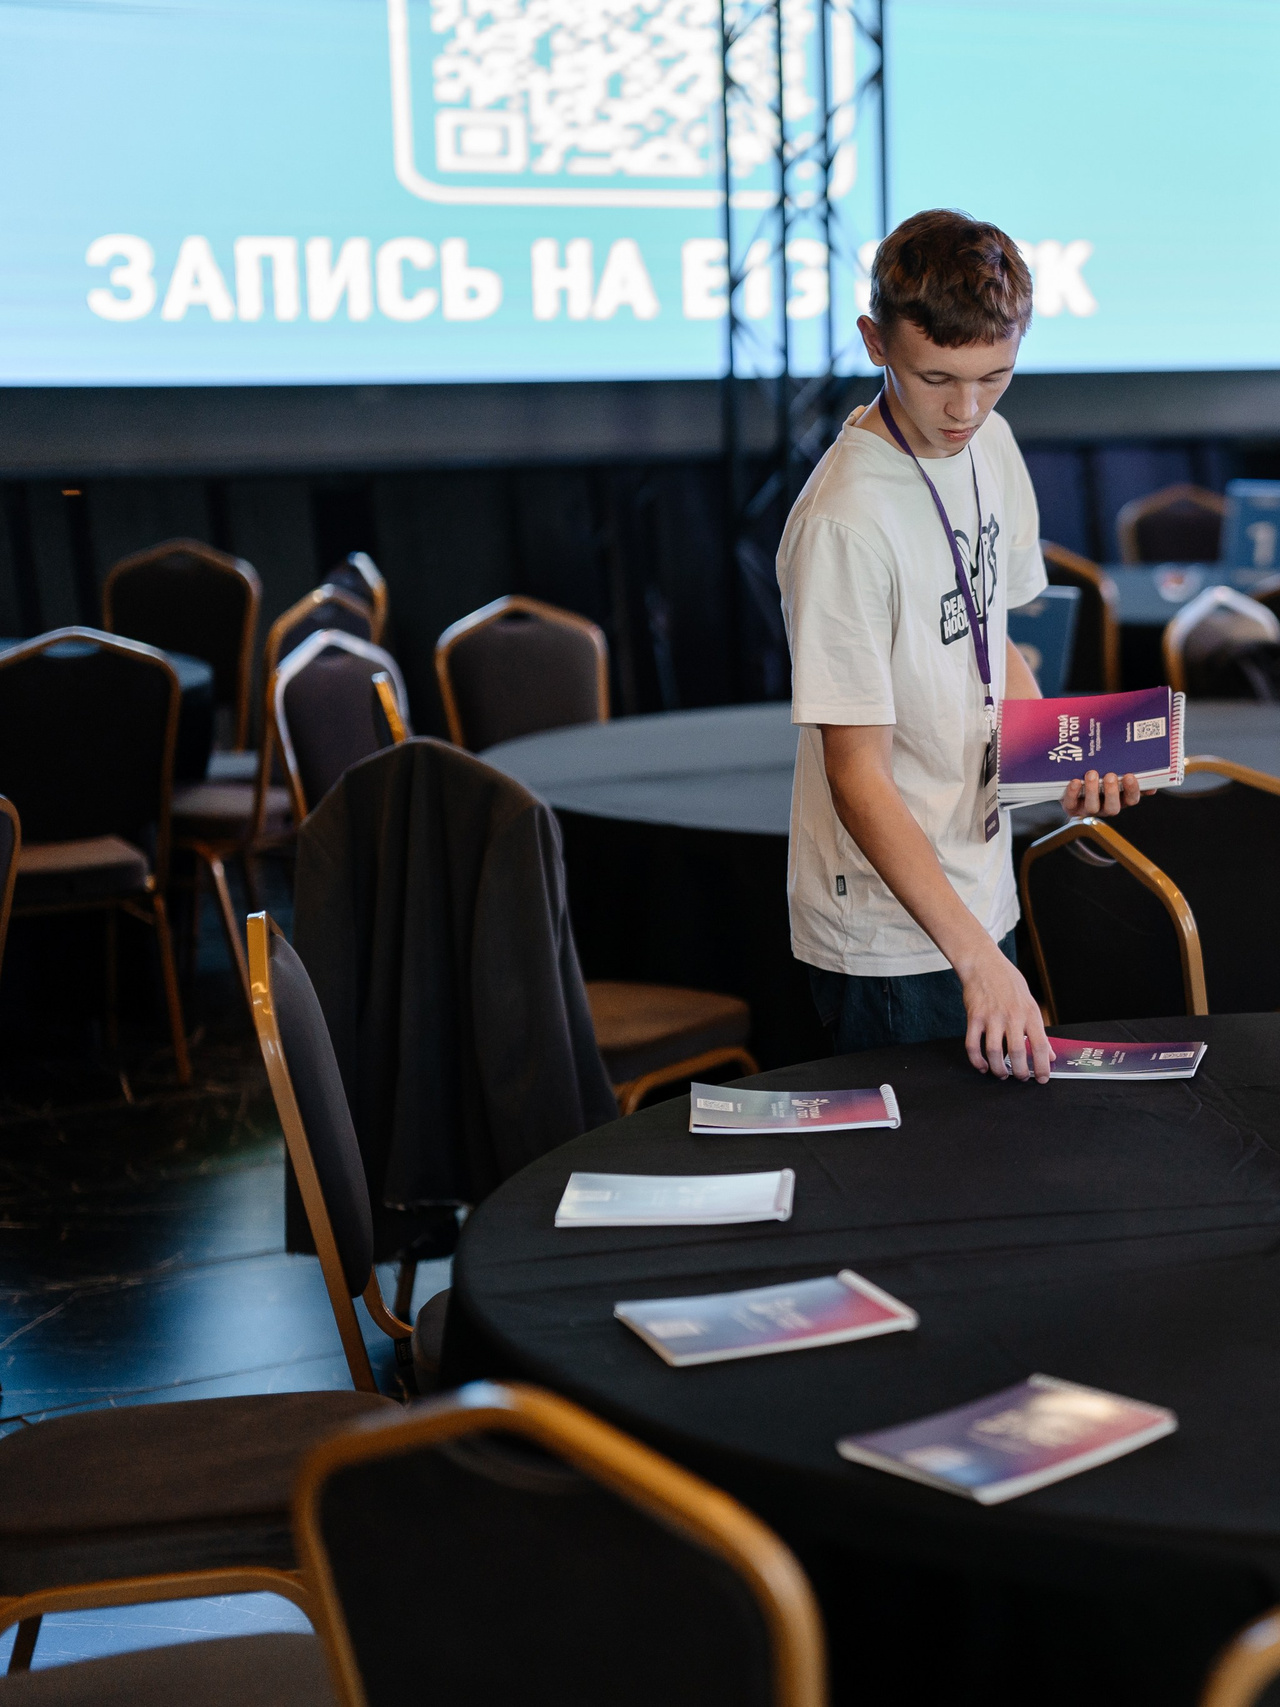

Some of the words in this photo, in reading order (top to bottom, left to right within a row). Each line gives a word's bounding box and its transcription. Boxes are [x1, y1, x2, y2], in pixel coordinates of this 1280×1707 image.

[84, 233, 504, 322] ЗАПИСЬ
[530, 236, 660, 322] НА
[1057, 714, 1069, 744] ТОПАЙ
[1069, 716, 1080, 737] ТОП
